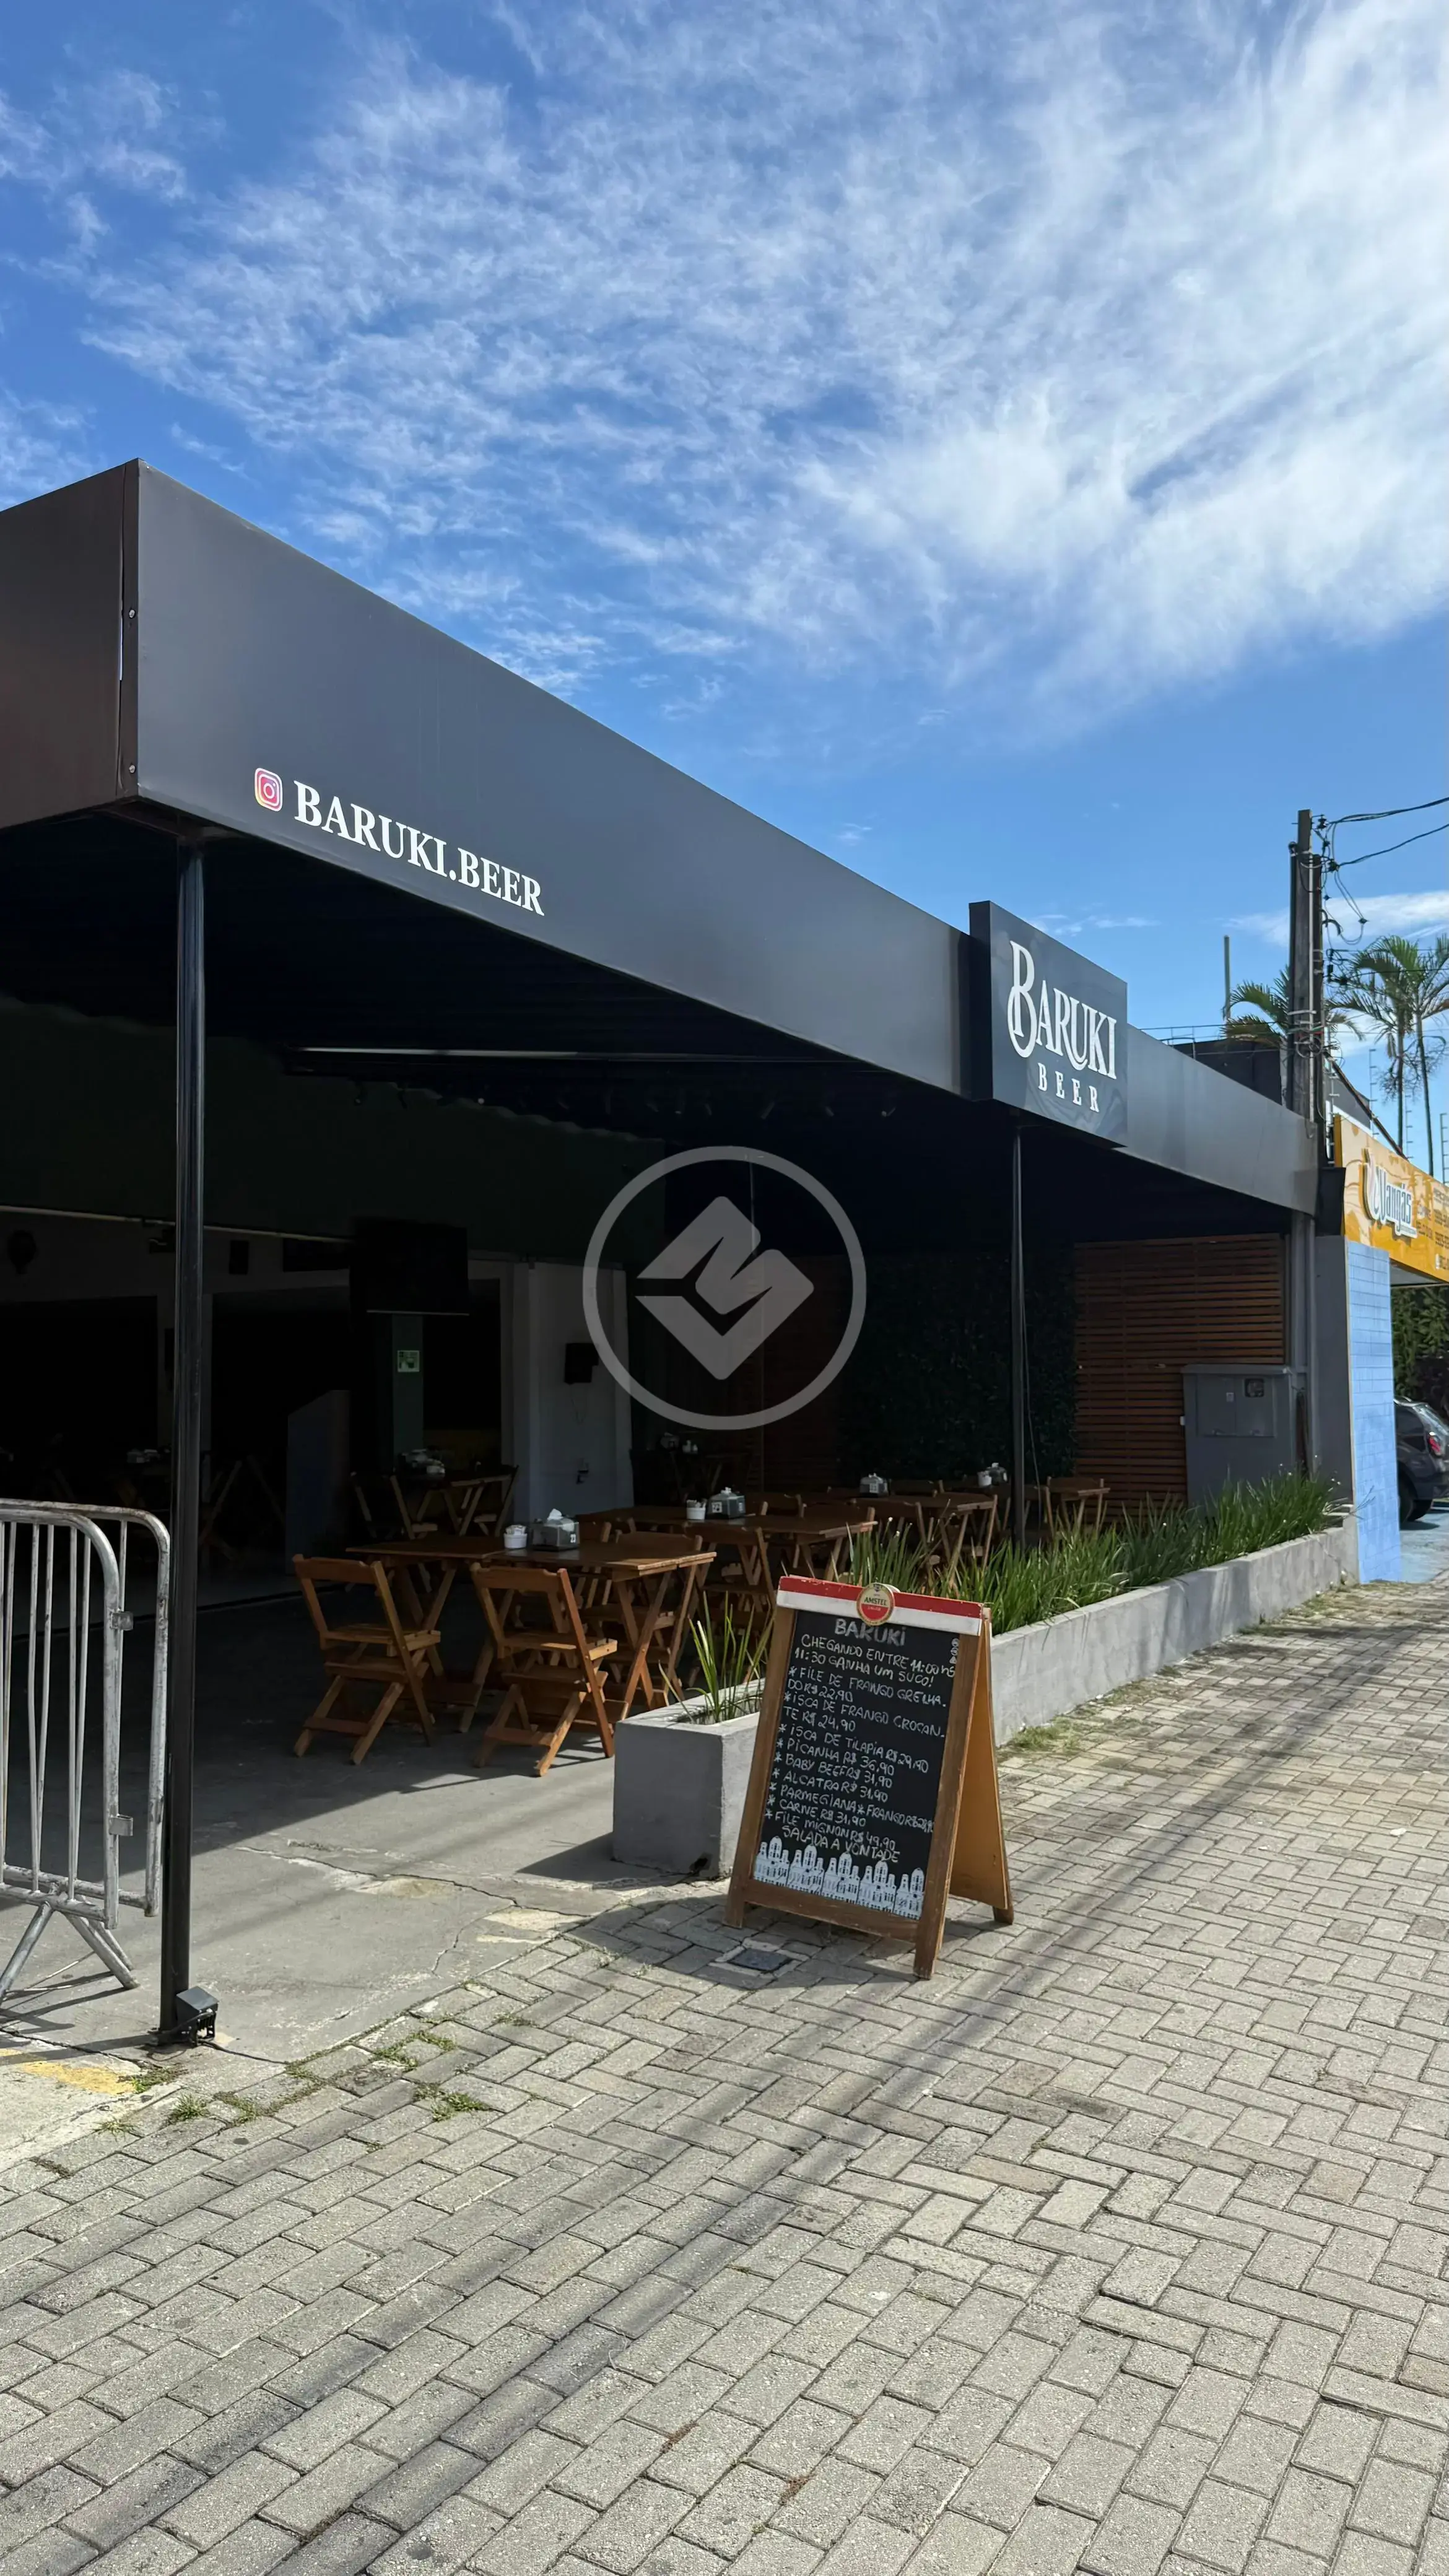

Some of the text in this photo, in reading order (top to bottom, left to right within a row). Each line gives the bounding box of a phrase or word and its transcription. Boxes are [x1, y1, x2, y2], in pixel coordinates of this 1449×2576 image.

[294, 780, 545, 916] BARUKI.BEER
[1007, 940, 1117, 1080] BARUKI
[1038, 1063, 1100, 1113] BEER
[864, 1596, 888, 1606] AMSTEL
[794, 1647, 826, 1664] 11:30
[829, 1655, 870, 1675] GANHA
[898, 1671, 934, 1687] SUCO!
[801, 1634, 863, 1657] CHEGANDO
[866, 1648, 909, 1669] ENTRE
[910, 1660, 939, 1675] 11:00
[829, 1673, 843, 1687] DE
[849, 1677, 894, 1698] FRANGO
[783, 1705, 799, 1720] TE
[822, 1699, 836, 1713] DE
[841, 1704, 889, 1725] FRANGO
[824, 1732, 841, 1746] DE
[785, 1753, 815, 1771] BABY
[783, 1770, 840, 1791] ALCATRA
[779, 1798, 818, 1817] CARNE
[781, 1825, 900, 1863] SALADA A VONTADE
